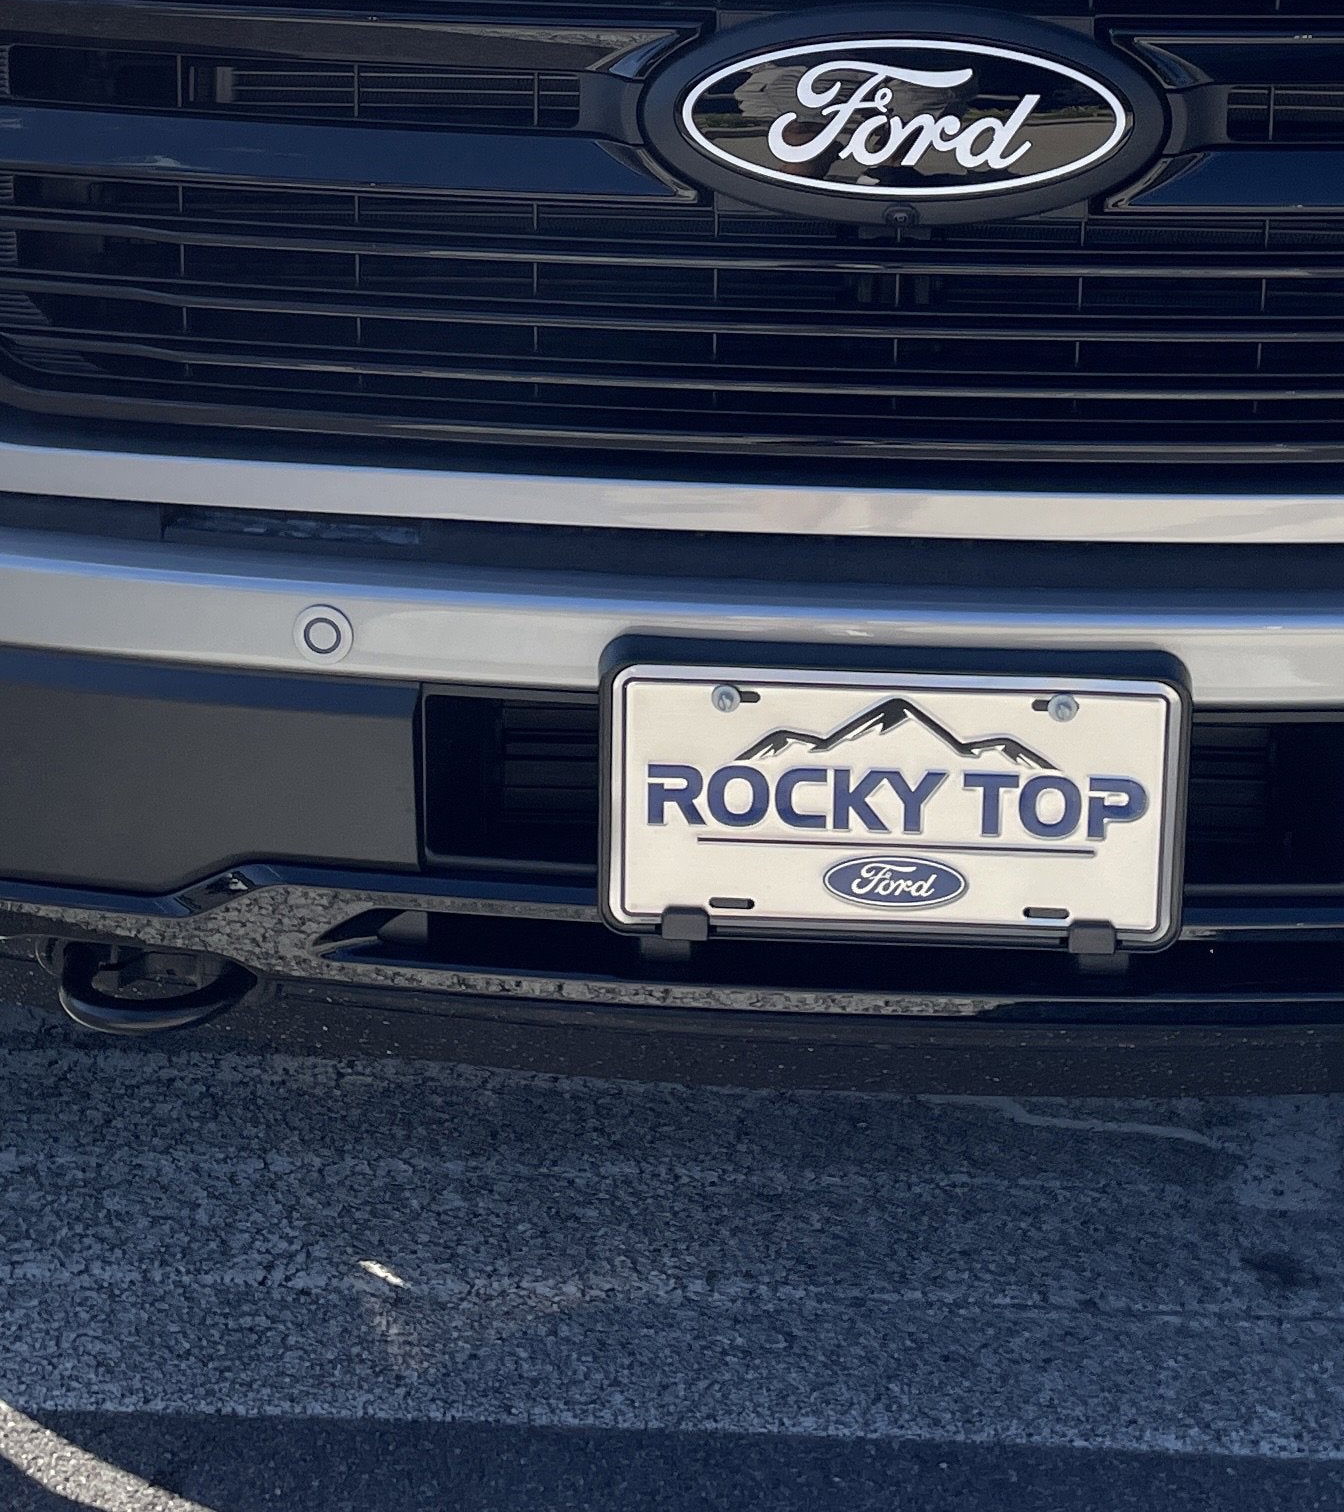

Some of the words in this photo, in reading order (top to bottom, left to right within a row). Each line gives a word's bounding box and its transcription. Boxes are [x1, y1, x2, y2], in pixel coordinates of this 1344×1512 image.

[768, 60, 1040, 170] Ford
[646, 763, 949, 835] ROCKY
[964, 771, 1149, 841] TOP
[851, 864, 937, 899] Ford
